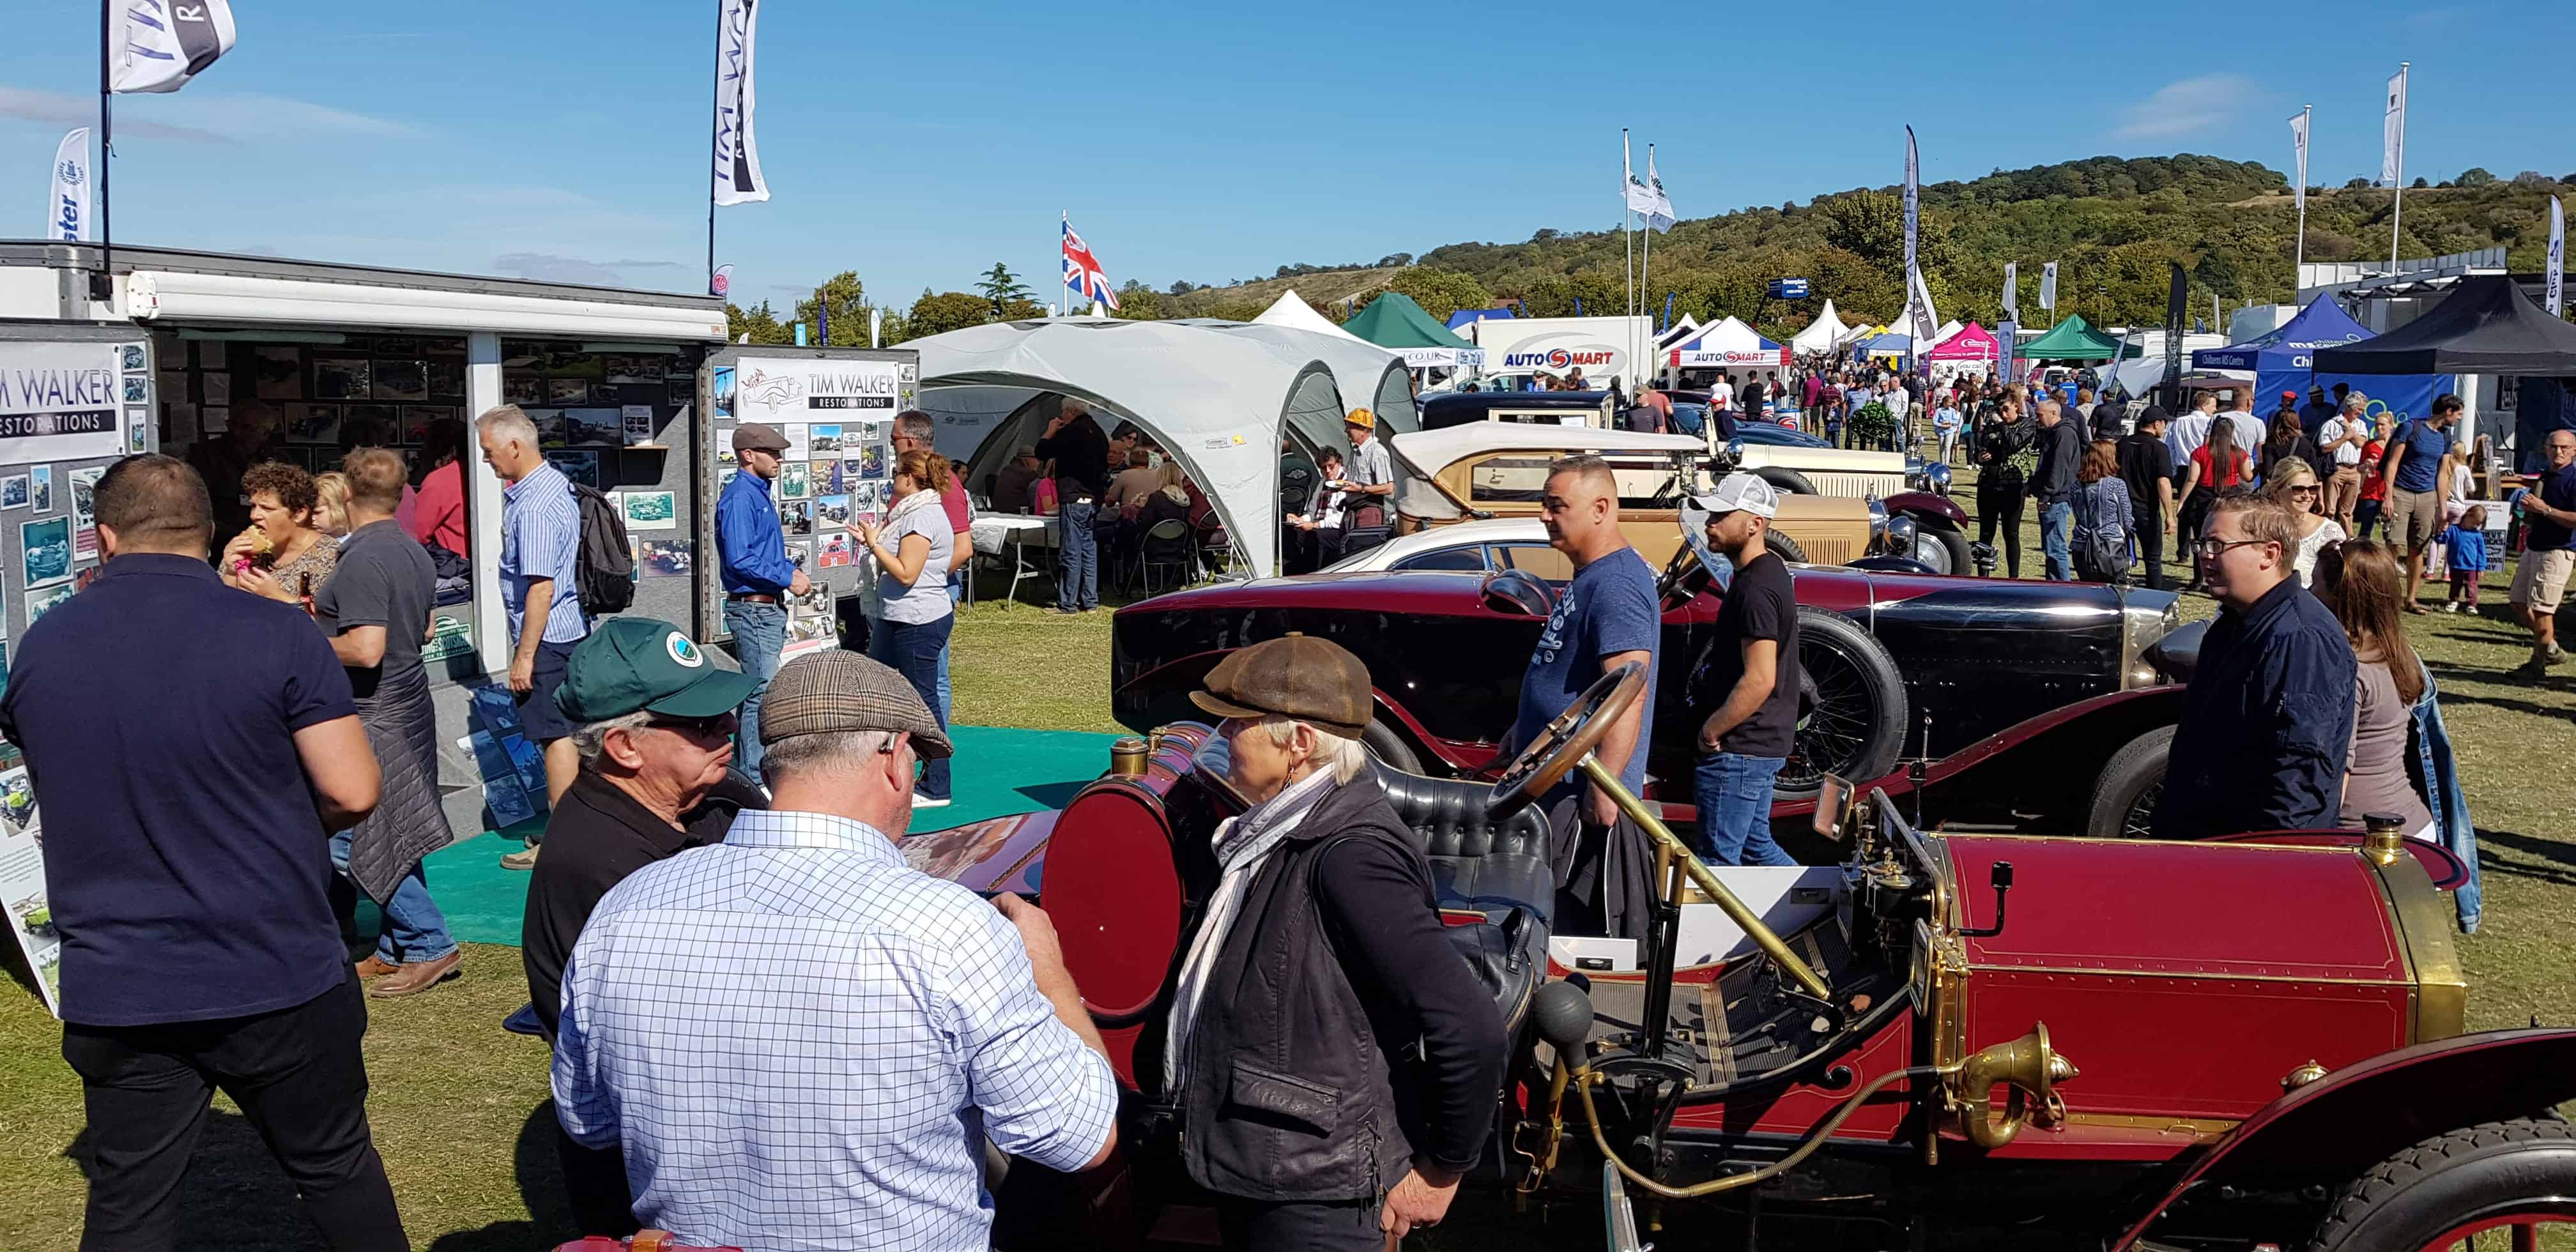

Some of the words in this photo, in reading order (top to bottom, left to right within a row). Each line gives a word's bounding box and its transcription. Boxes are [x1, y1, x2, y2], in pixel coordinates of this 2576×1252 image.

[17, 369, 115, 408] WALKER
[808, 374, 834, 393] TIM
[839, 374, 894, 393] WALKER
